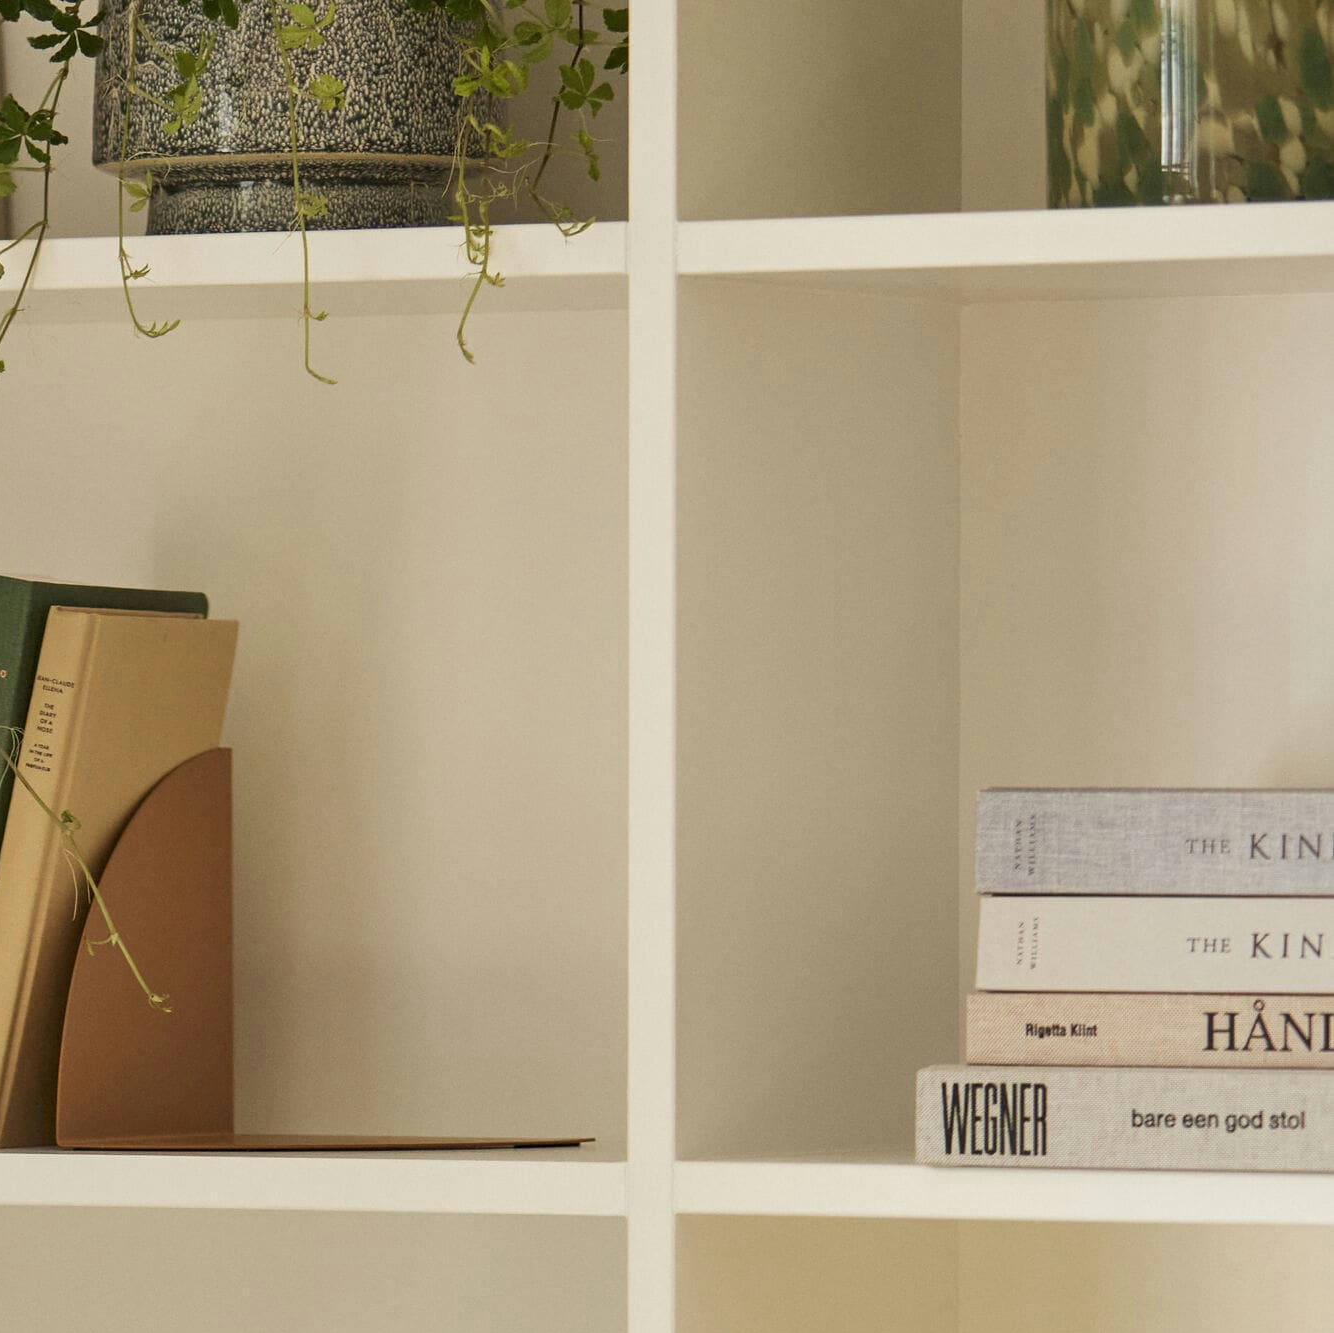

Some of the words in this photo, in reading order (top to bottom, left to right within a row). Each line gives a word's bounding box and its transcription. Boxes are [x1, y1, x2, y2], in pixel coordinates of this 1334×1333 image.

[1185, 837, 1232, 855] THE
[1249, 832, 1334, 861] KIN
[1186, 937, 1233, 954] THE
[1250, 932, 1334, 959] KIN
[1070, 1023, 1098, 1037] Klint
[941, 1082, 1048, 1156] WEGNER
[1131, 1108, 1176, 1129] bare
[1182, 1112, 1219, 1129] een
[1226, 1109, 1264, 1134] god
[1269, 1110, 1306, 1130] stol
